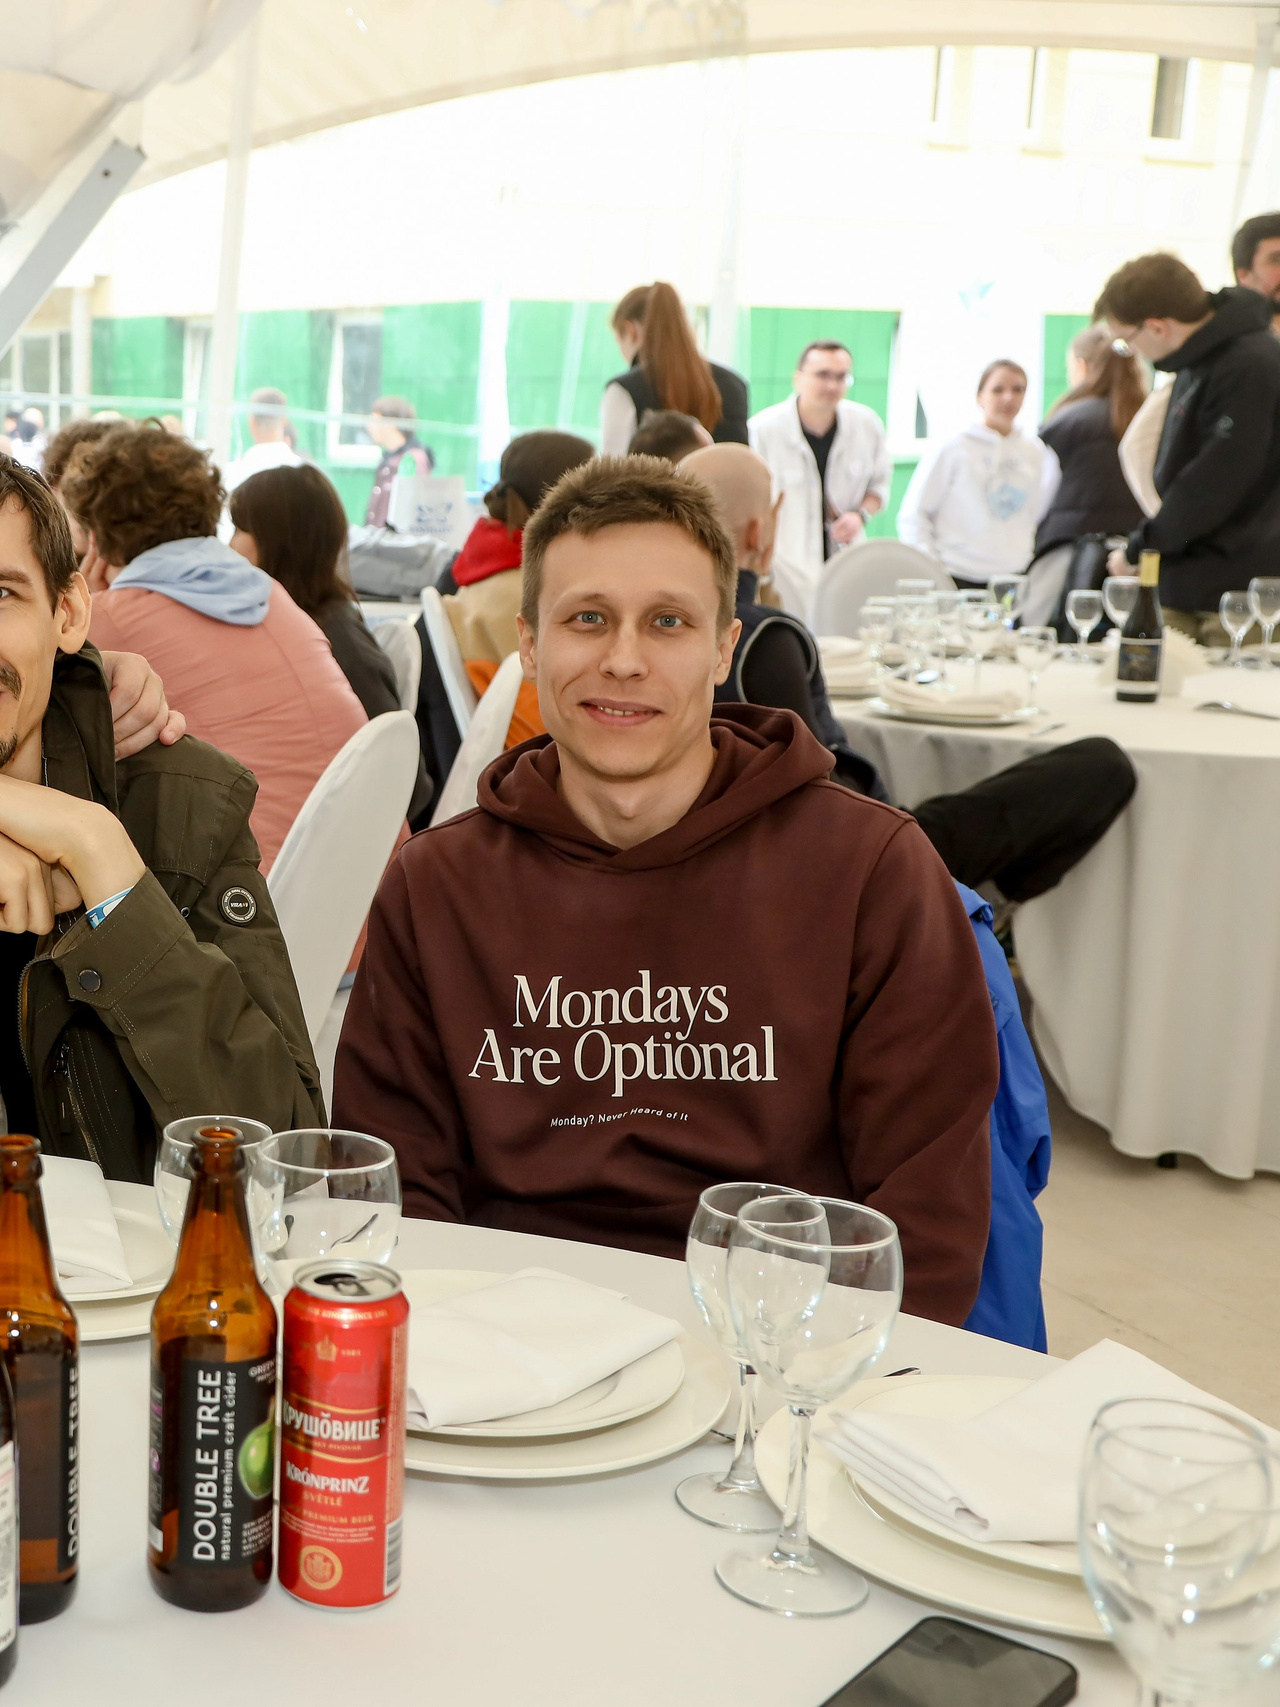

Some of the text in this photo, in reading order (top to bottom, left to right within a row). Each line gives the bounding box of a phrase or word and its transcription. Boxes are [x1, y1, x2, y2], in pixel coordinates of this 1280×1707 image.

[513, 969, 730, 1041] Mondays
[468, 1025, 779, 1098] Are Optional
[550, 1107, 689, 1128] Monday? Never Heard of It
[192, 1369, 221, 1561] DOUBLE TREE
[219, 1370, 237, 1561] natural premium craft cider
